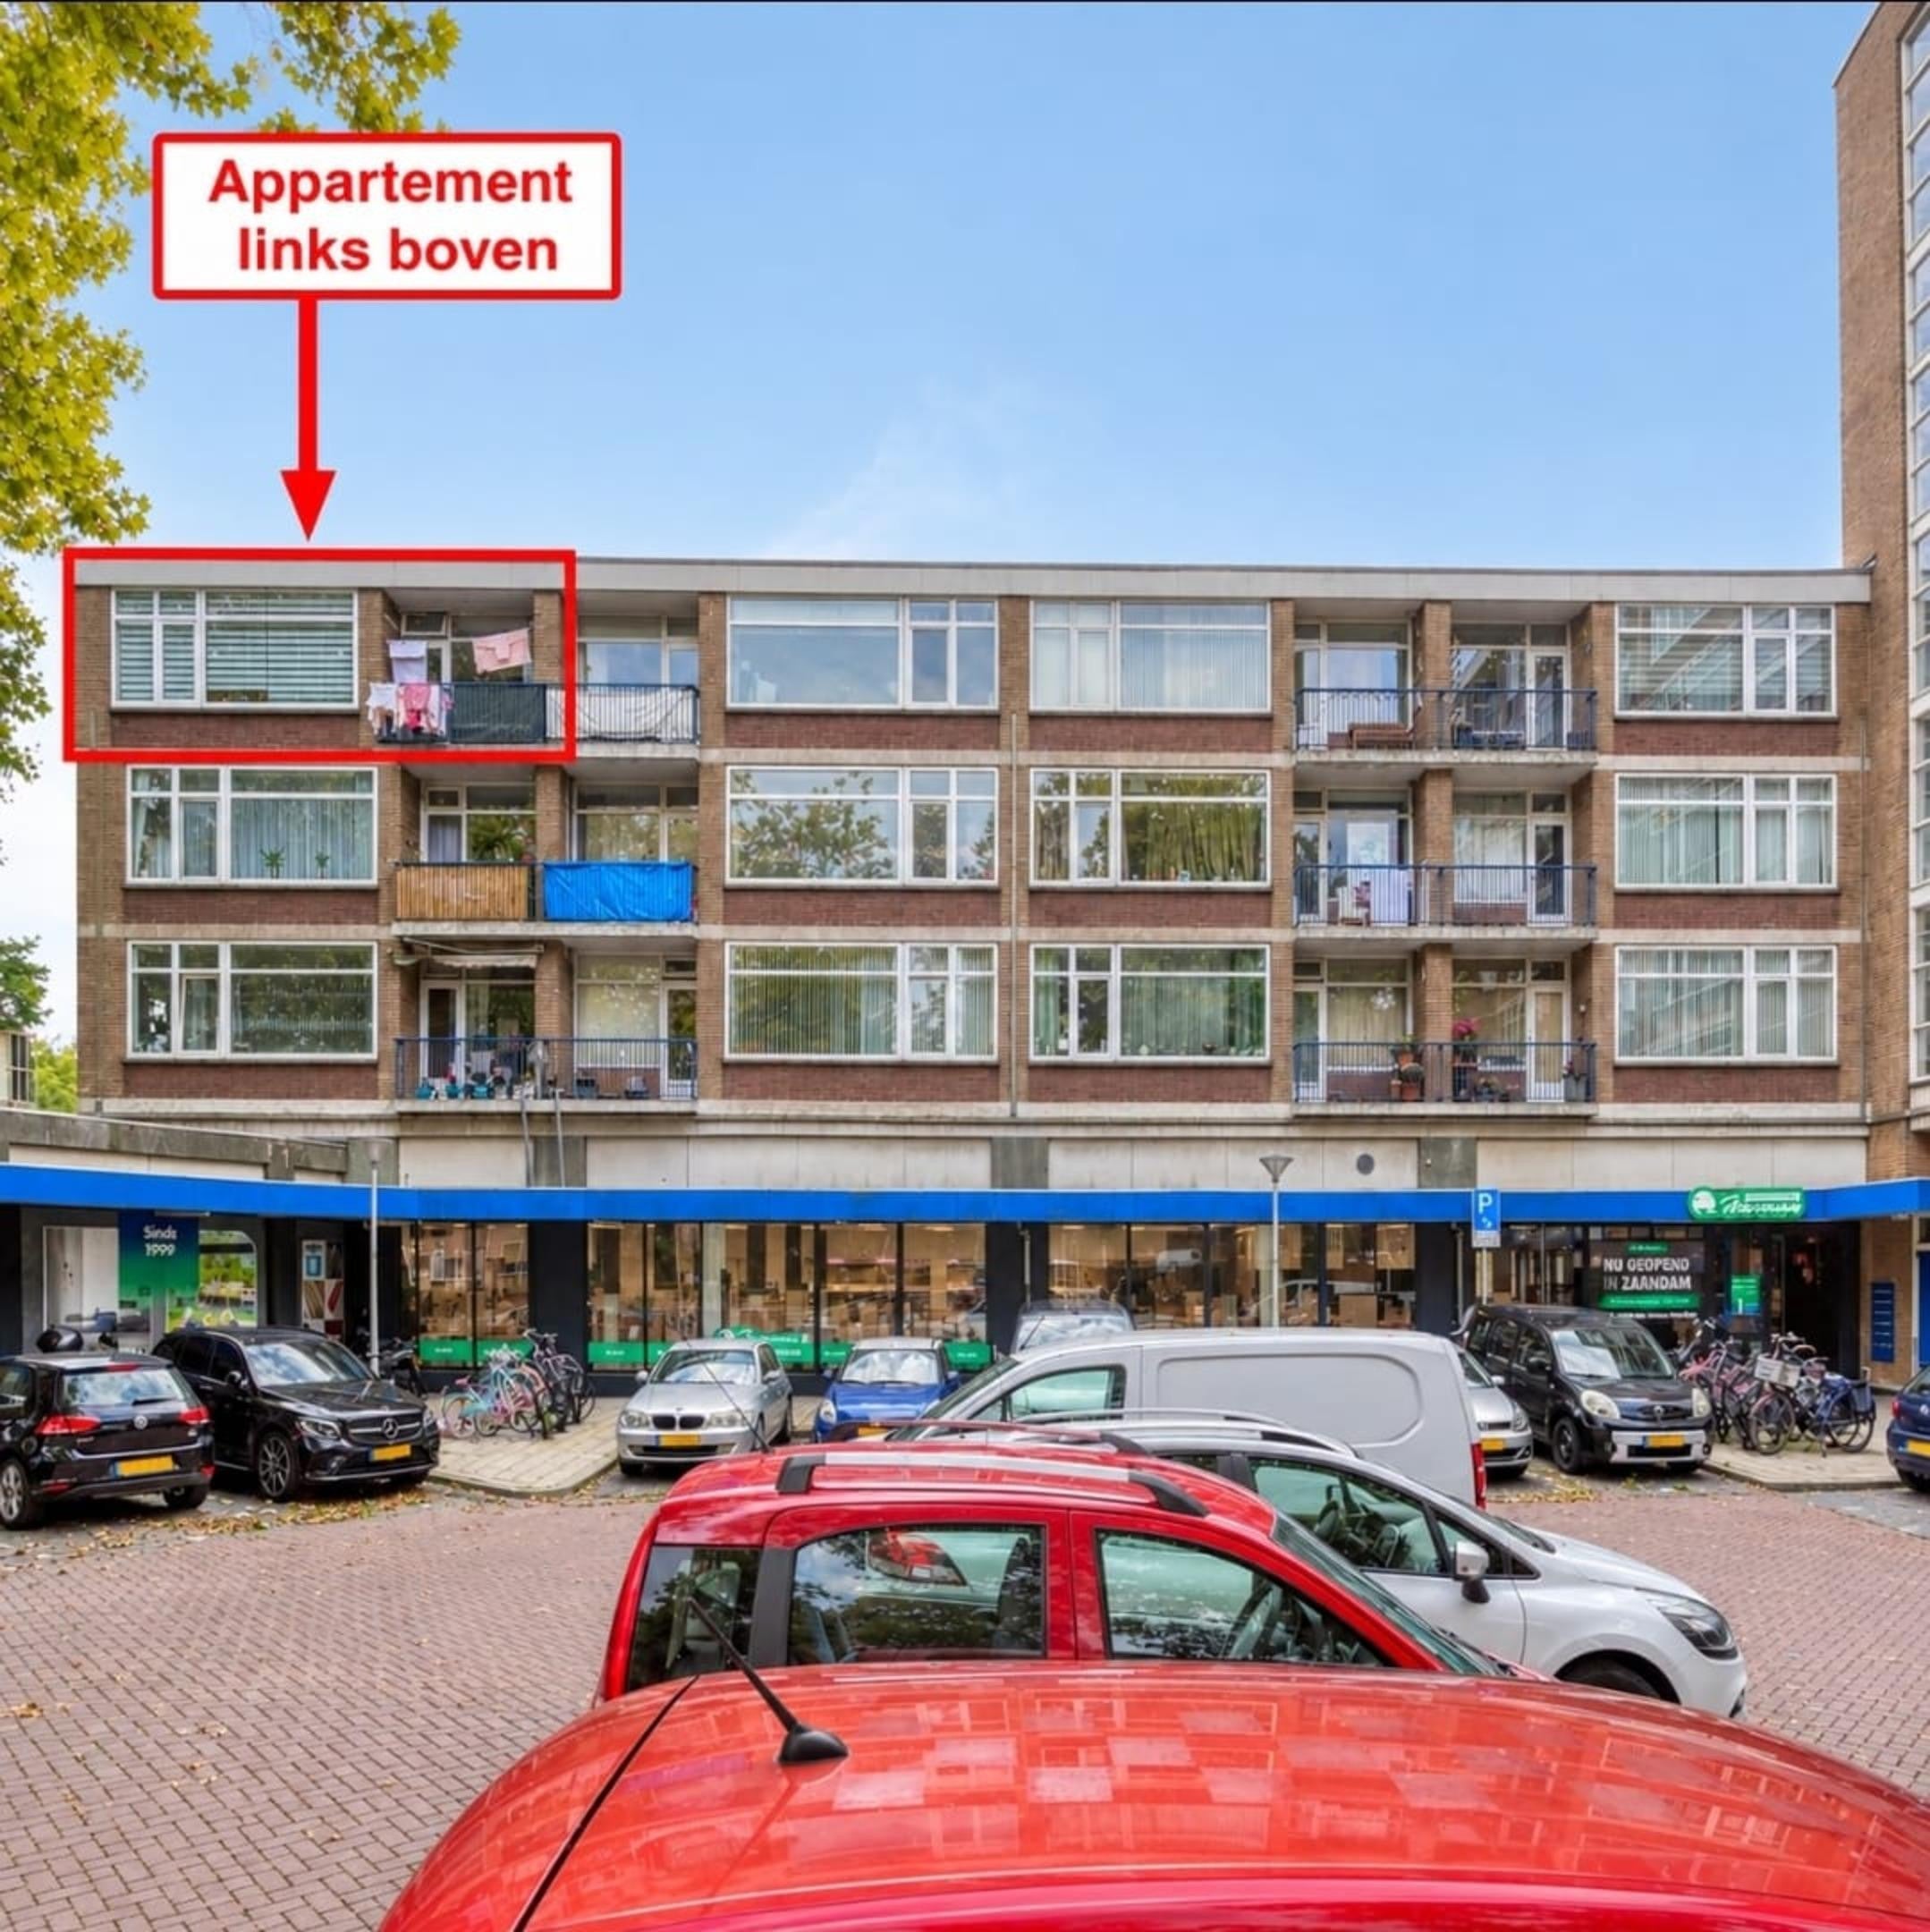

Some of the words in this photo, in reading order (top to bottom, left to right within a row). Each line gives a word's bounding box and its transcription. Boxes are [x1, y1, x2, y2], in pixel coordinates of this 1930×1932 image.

[1478, 1192, 1492, 1215] P
[143, 1224, 177, 1240] Sinds
[145, 1243, 176, 1257] 1999
[1604, 1258, 1622, 1271] NU
[1627, 1258, 1689, 1271] GEOPEND
[1604, 1276, 1618, 1290] IN
[1621, 1275, 1691, 1290] ZAANDAM
